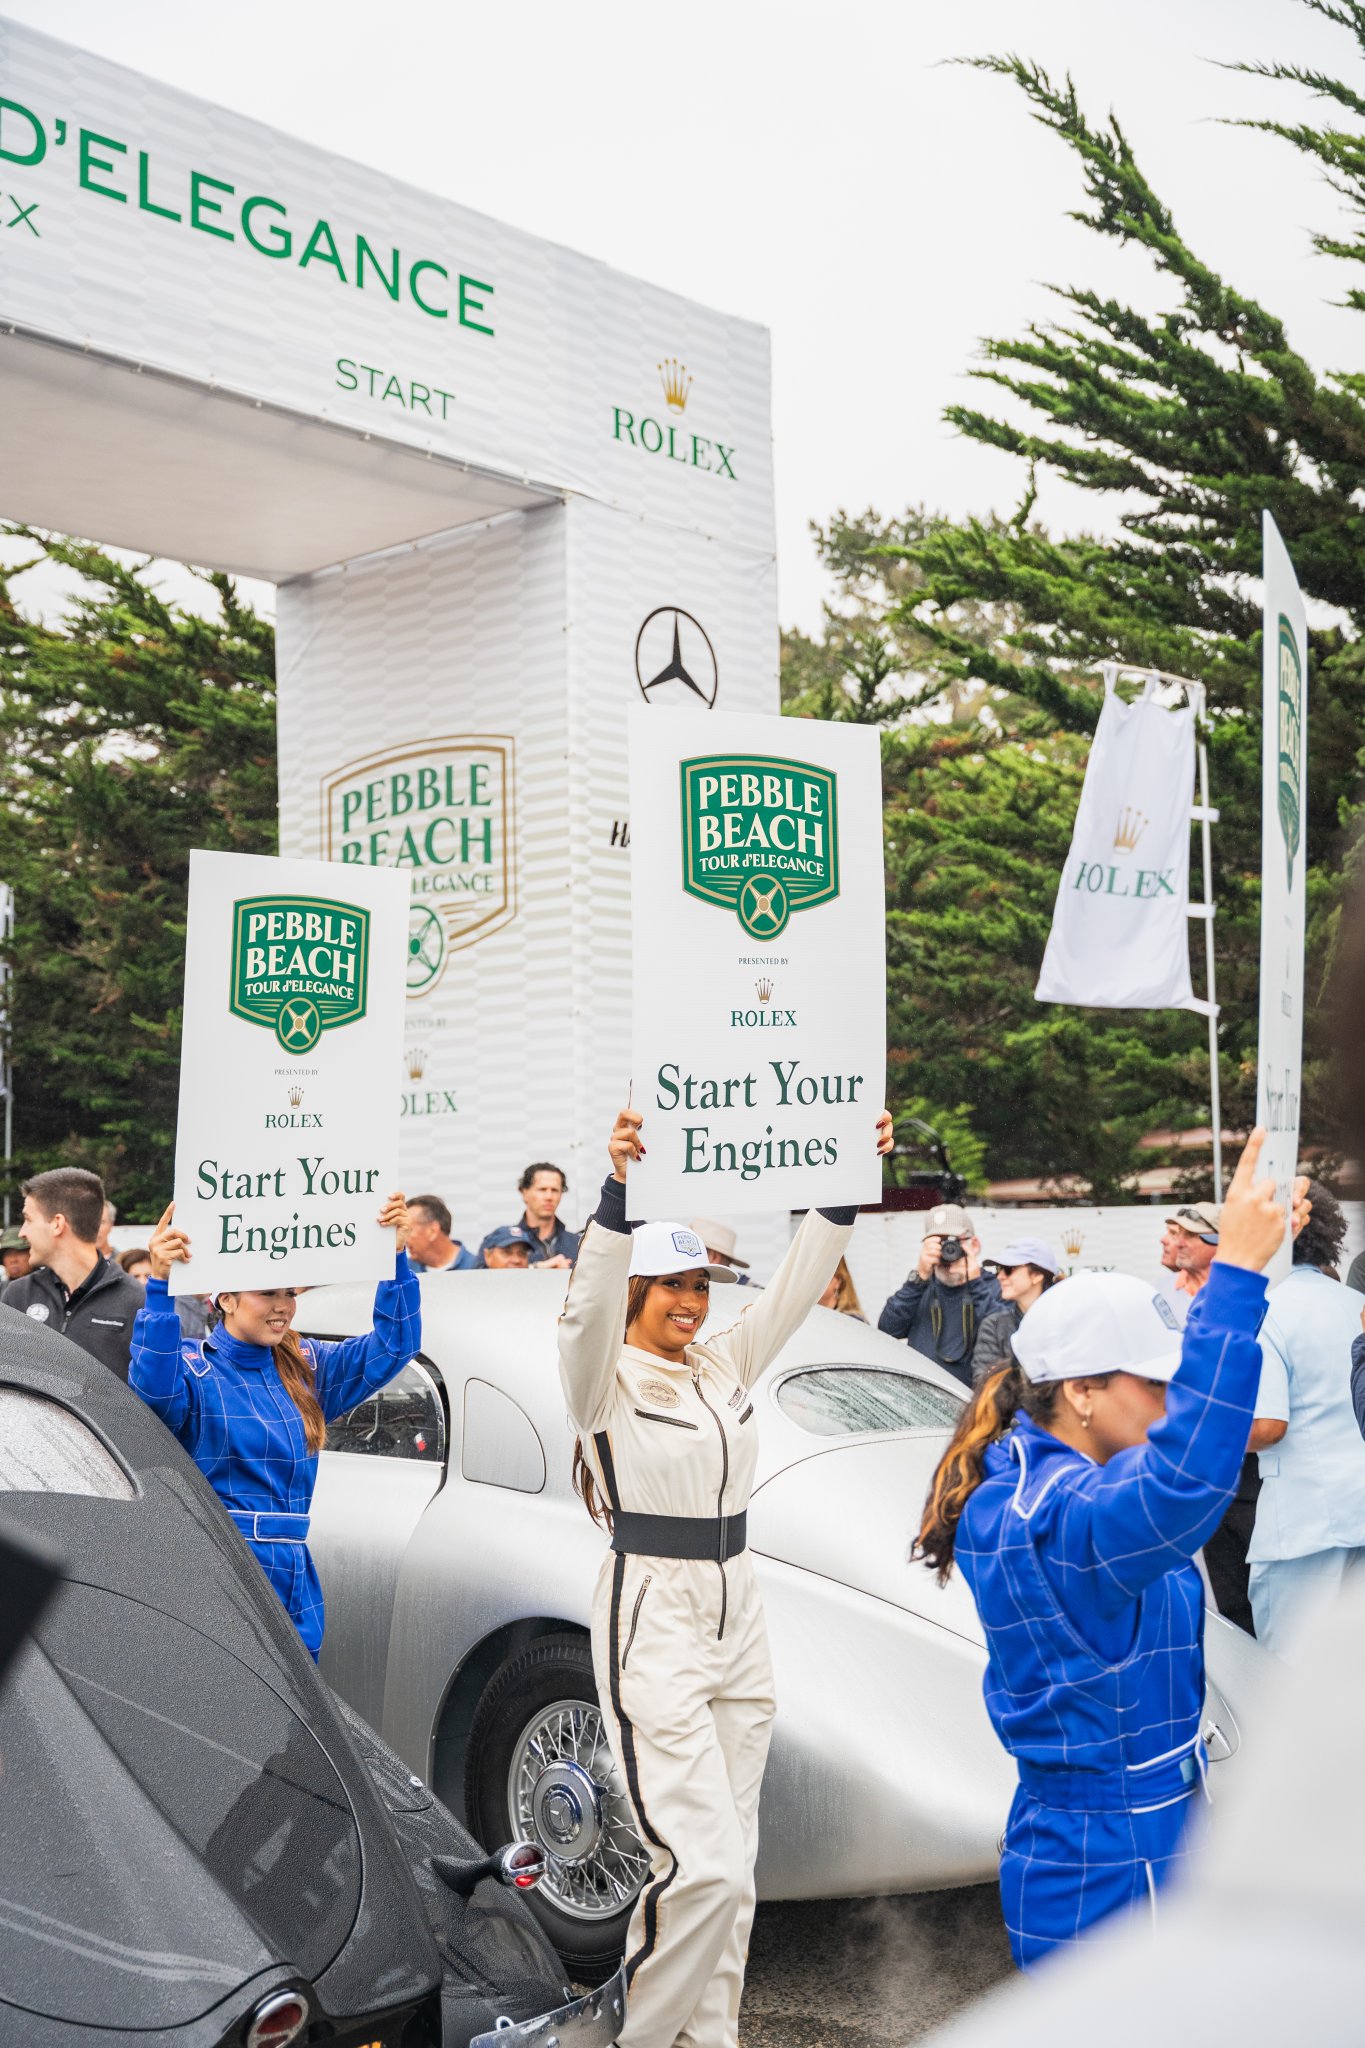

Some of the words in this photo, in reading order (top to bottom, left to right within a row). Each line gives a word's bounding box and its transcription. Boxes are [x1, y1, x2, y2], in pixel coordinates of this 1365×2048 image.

[336, 358, 456, 420] START
[611, 405, 738, 481] ROLEX
[342, 763, 492, 834] PEBBLE
[698, 774, 823, 817] PEBBLE
[698, 812, 824, 858] BEACH
[411, 872, 495, 895] LEGANCE
[699, 853, 739, 872] TOUR
[742, 853, 825, 877] d'ELEGANCE
[248, 911, 357, 949] PEBBLE
[245, 944, 356, 984] BEACH
[738, 957, 779, 966] PRESENTED
[780, 957, 789, 966] BY
[245, 980, 280, 996] TOUR
[282, 979, 355, 1000] d'ELEGANCE
[730, 1009, 798, 1028] ROLEX
[274, 1068, 310, 1076] PRESENTED
[656, 1063, 757, 1111] Start
[769, 1060, 864, 1106] Your
[264, 1113, 324, 1129] ROLEX
[681, 1124, 838, 1181] Engines
[196, 1159, 287, 1200] Start
[297, 1157, 380, 1196] Your
[217, 1211, 357, 1260] Engines
